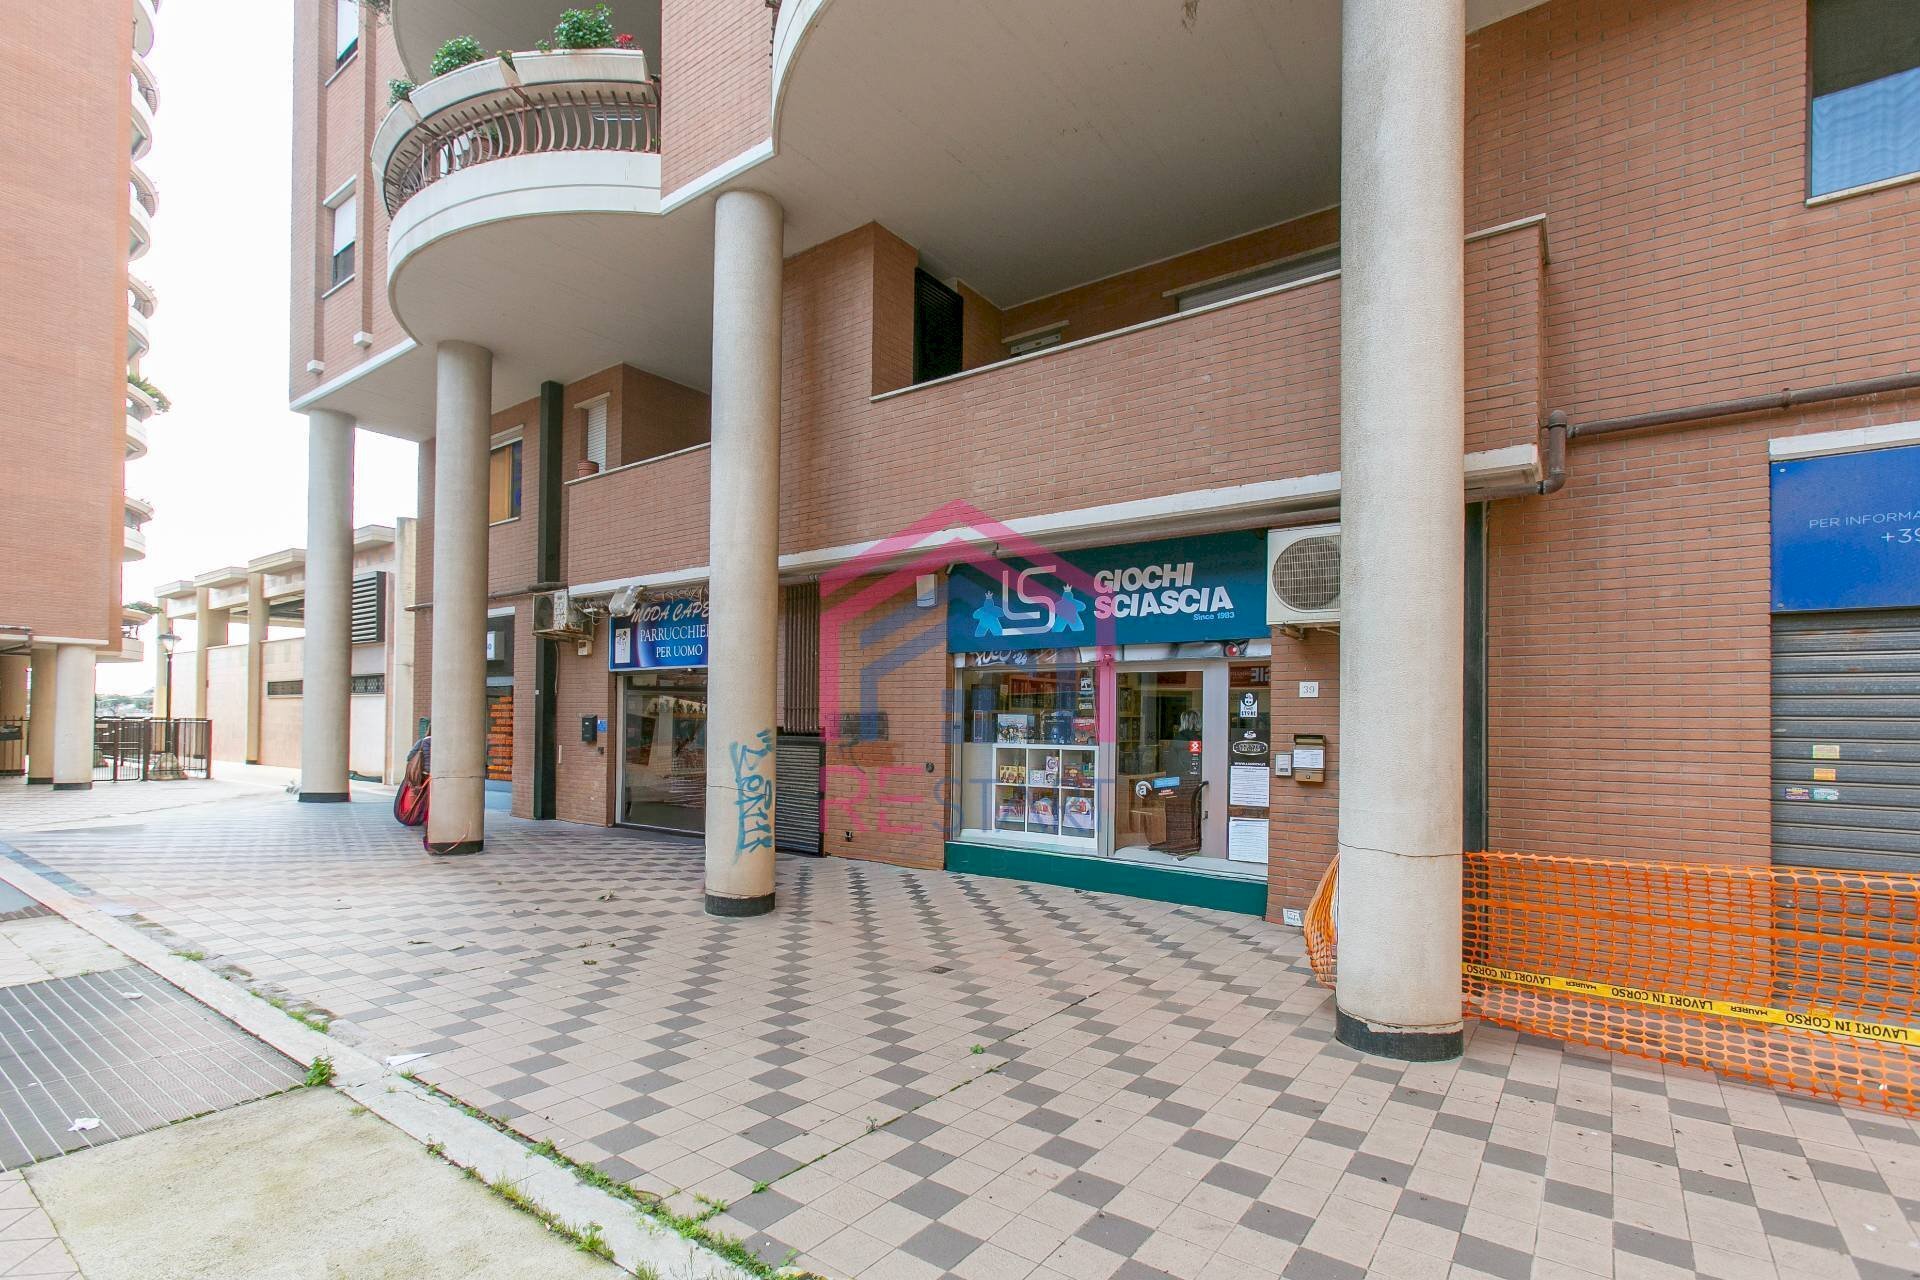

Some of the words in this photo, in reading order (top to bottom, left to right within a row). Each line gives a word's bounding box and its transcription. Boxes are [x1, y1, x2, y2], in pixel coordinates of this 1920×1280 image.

[1809, 517, 1841, 529] PER
[1845, 510, 1920, 526] INFORMA
[1094, 562, 1194, 594] GIOCHI
[1094, 586, 1234, 620] SCIASCIA
[631, 605, 670, 623] MODA
[640, 624, 709, 642] PARRUCCHIE
[656, 646, 671, 658] PER
[673, 644, 703, 657] UOMO
[1466, 964, 1498, 978] CORSO
[1500, 970, 1511, 979] IN
[1515, 973, 1551, 986] LAVORI
[1611, 987, 1649, 1001] CORSO
[1652, 992, 1665, 1003] IN
[1669, 995, 1713, 1011] LAVORI
[1730, 1005, 1768, 1016] MAURER
[1785, 1013, 1831, 1029] CORSO
[1835, 1020, 1852, 1032] IN
[1856, 1022, 1908, 1041] LAVORI
